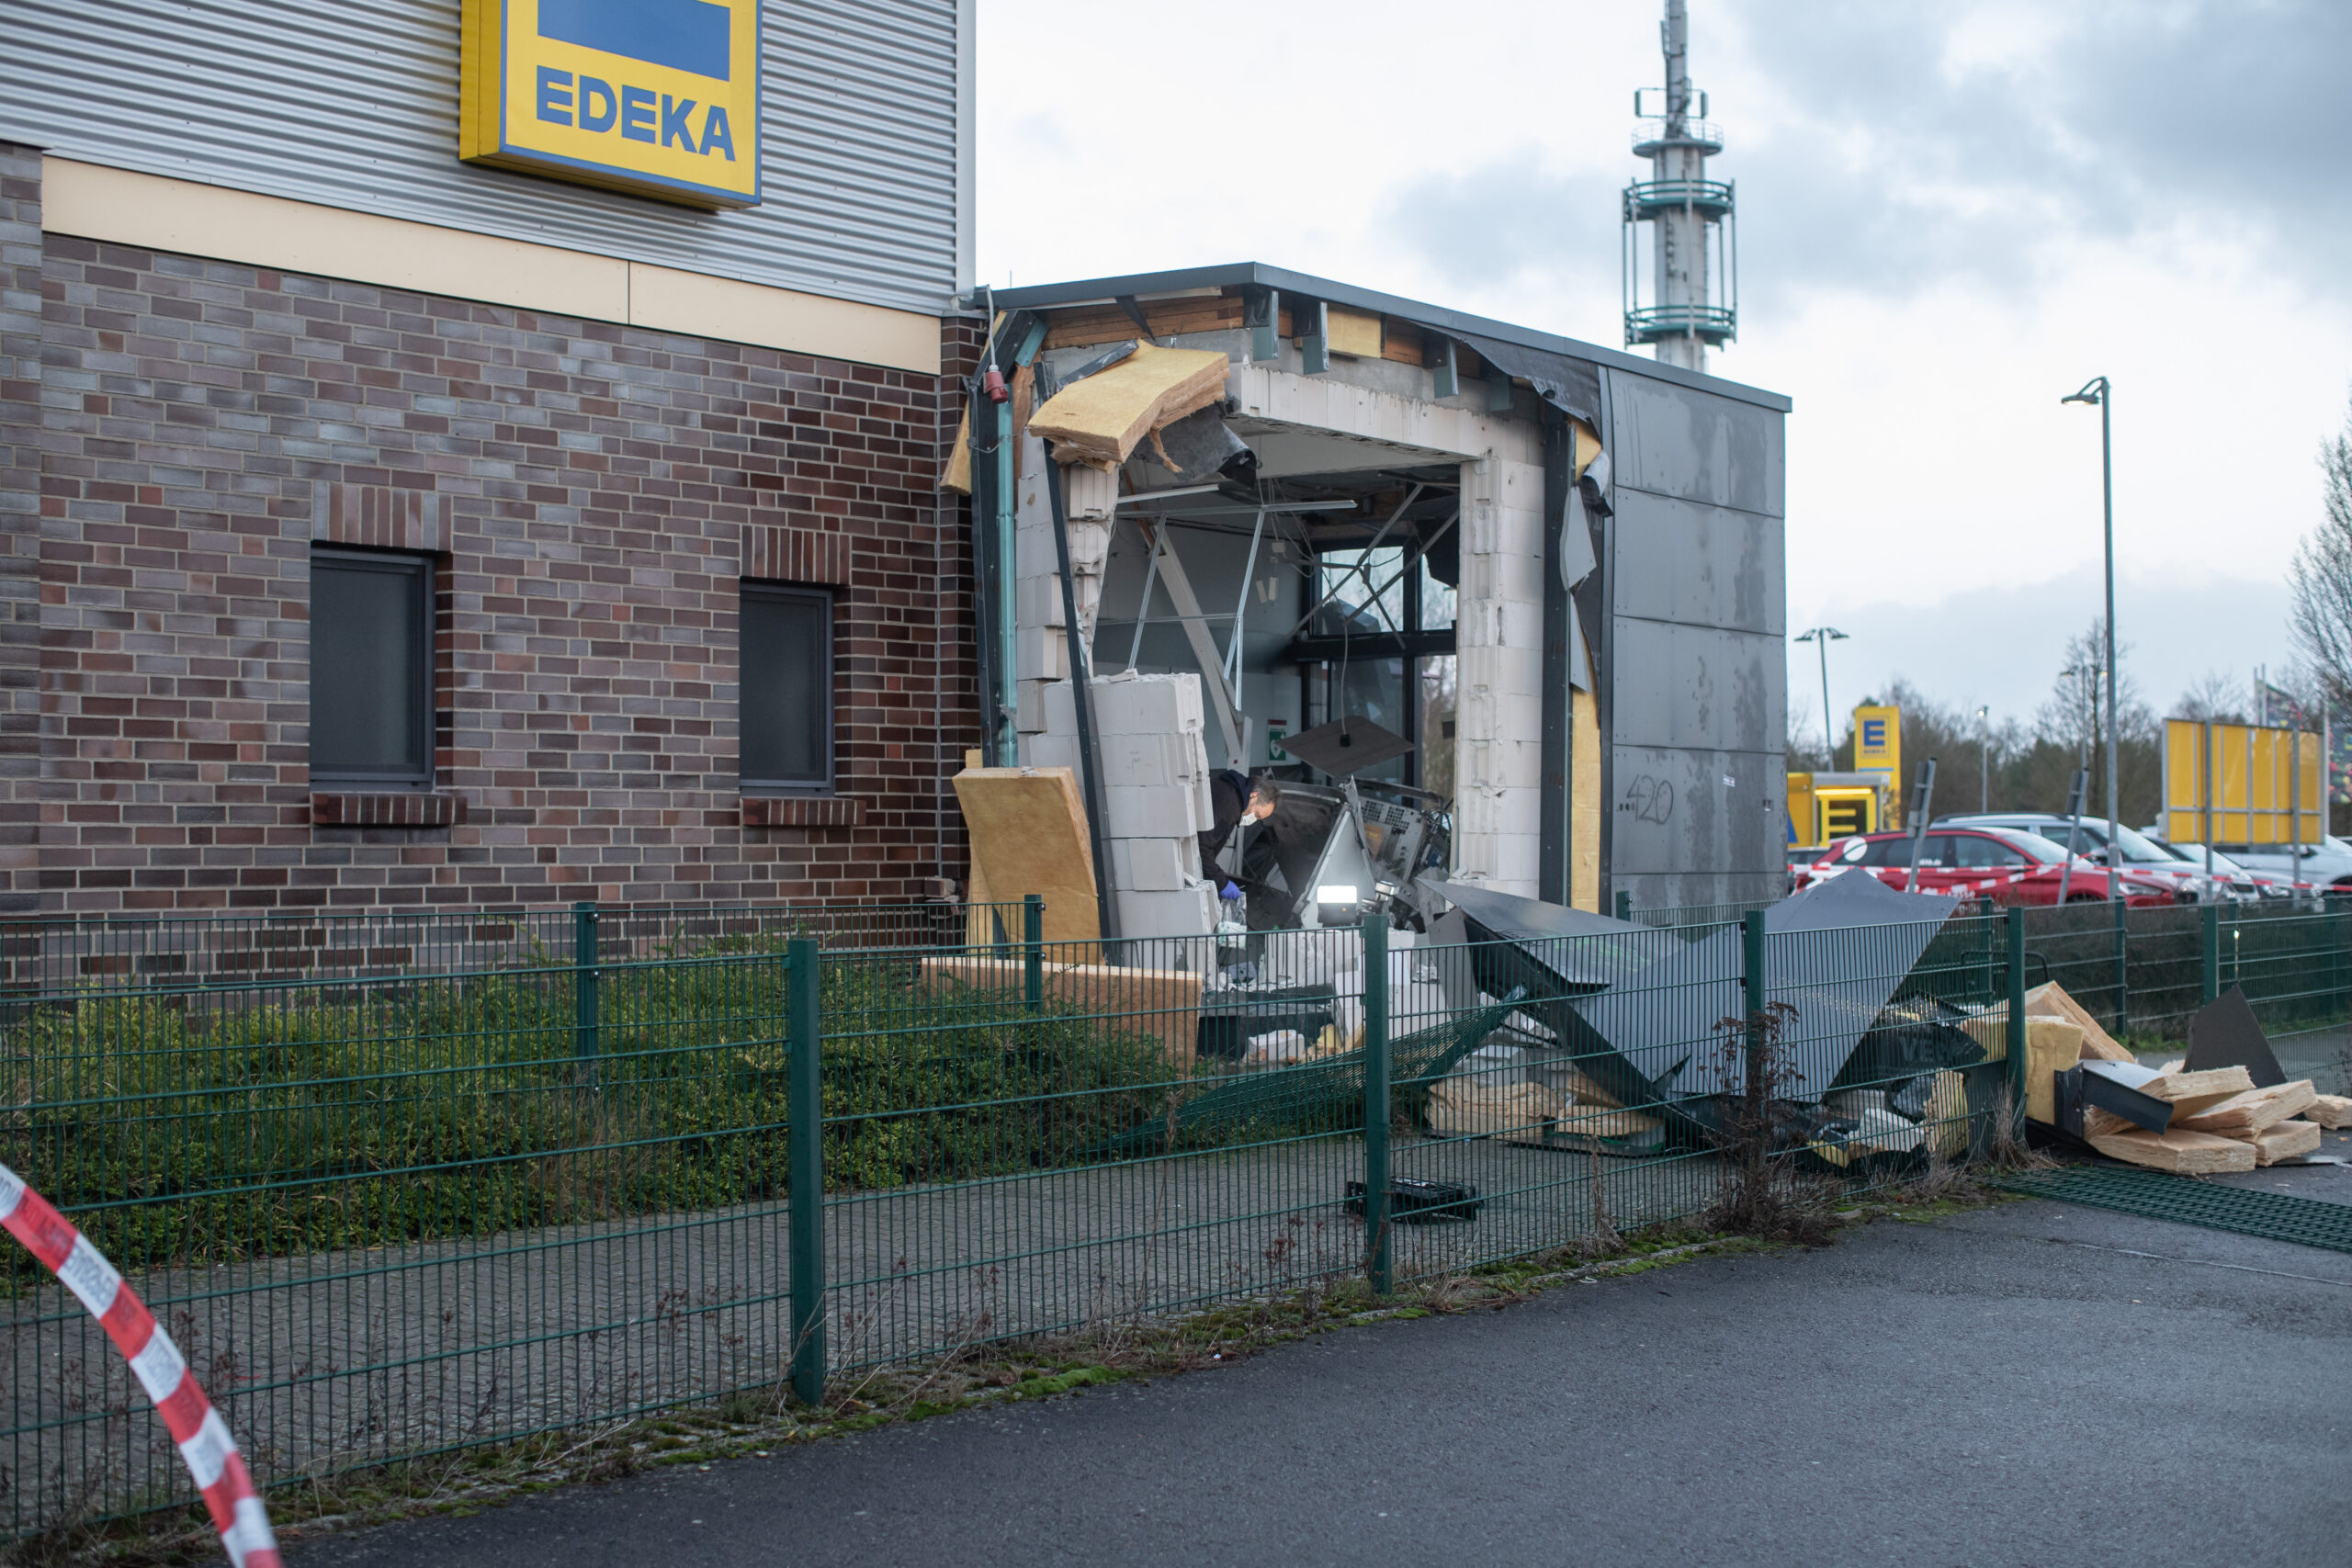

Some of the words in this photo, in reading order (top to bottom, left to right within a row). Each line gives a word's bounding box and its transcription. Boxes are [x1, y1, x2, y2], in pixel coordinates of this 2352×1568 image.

[537, 64, 736, 162] EDEKA
[1863, 720, 1885, 746] E
[1626, 774, 1674, 825] 420
